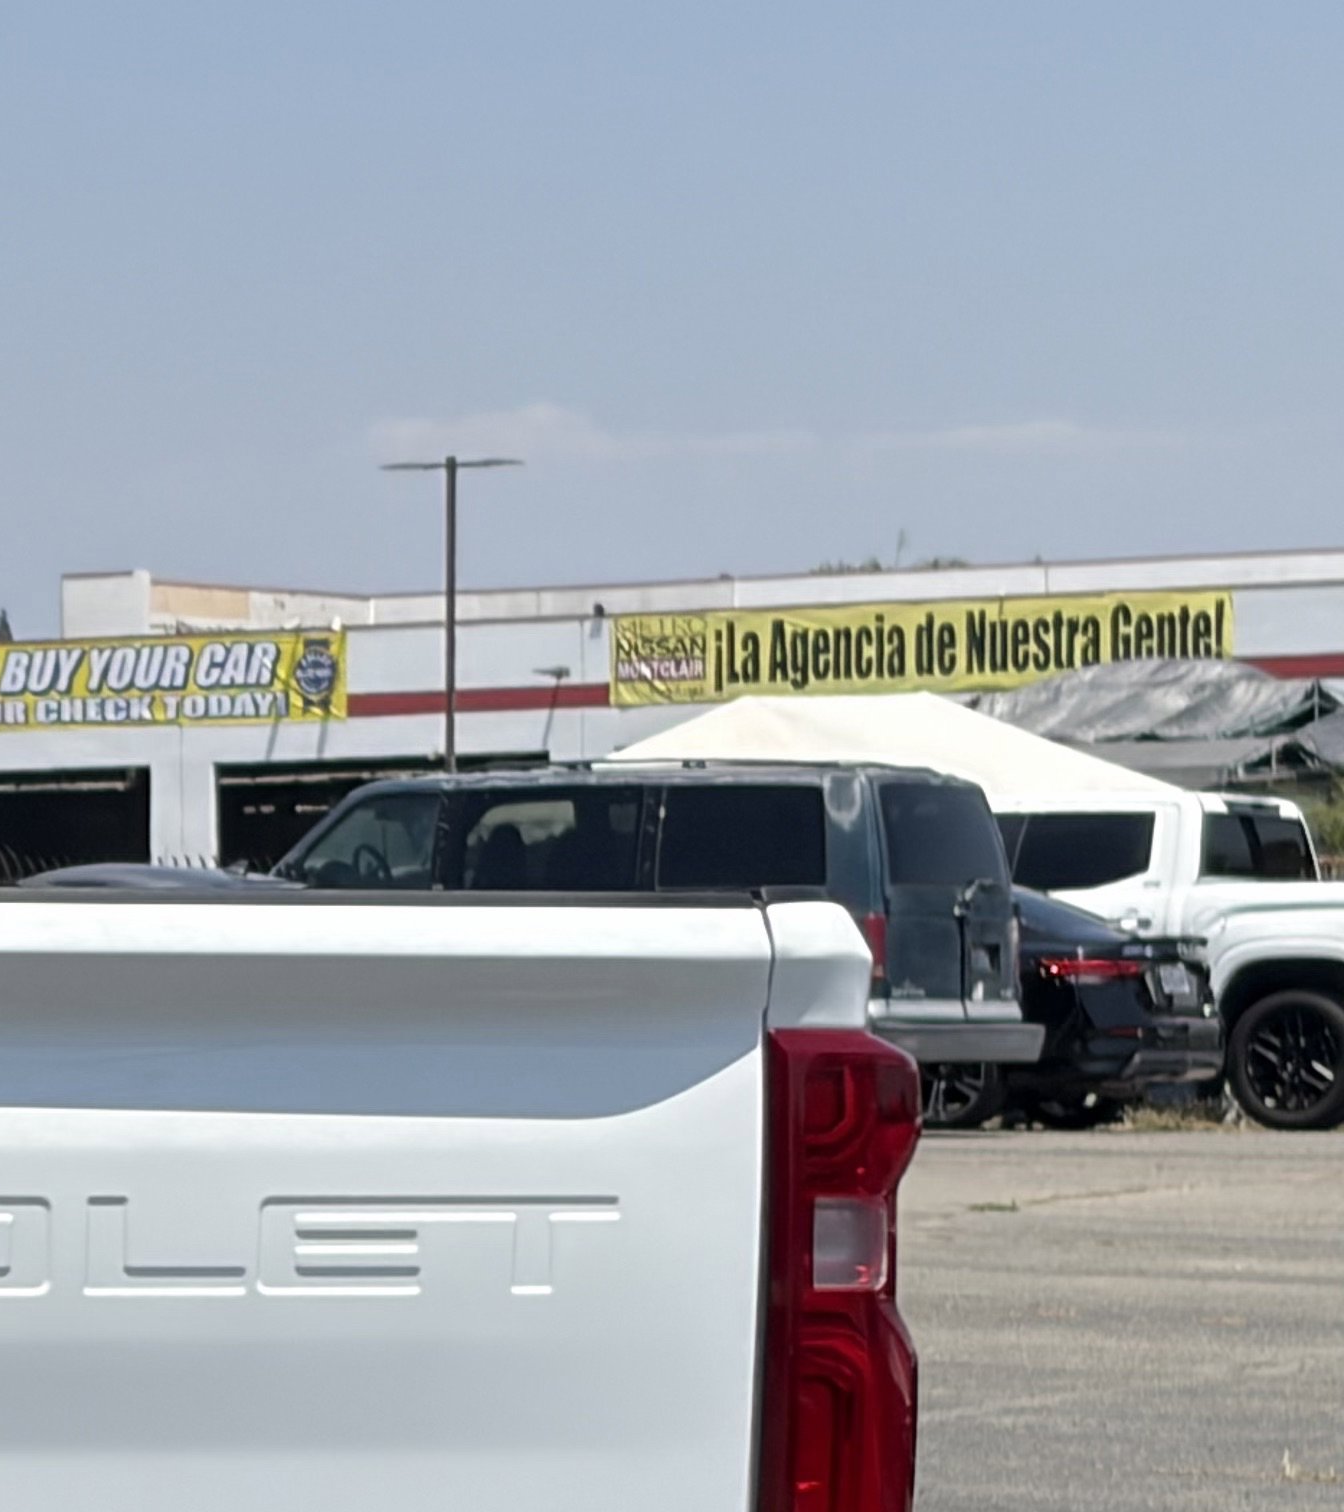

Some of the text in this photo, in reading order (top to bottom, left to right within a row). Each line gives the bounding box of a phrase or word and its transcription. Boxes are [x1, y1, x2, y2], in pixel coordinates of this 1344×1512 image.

[0, 646, 84, 697] BUY
[86, 644, 192, 692] YOUR
[194, 641, 280, 688] CAR
[768, 613, 906, 690] Agencia
[915, 611, 957, 677] de
[965, 608, 1102, 674] Nuestra
[1111, 598, 1225, 660] Gente!
[35, 696, 152, 724] CHECK
